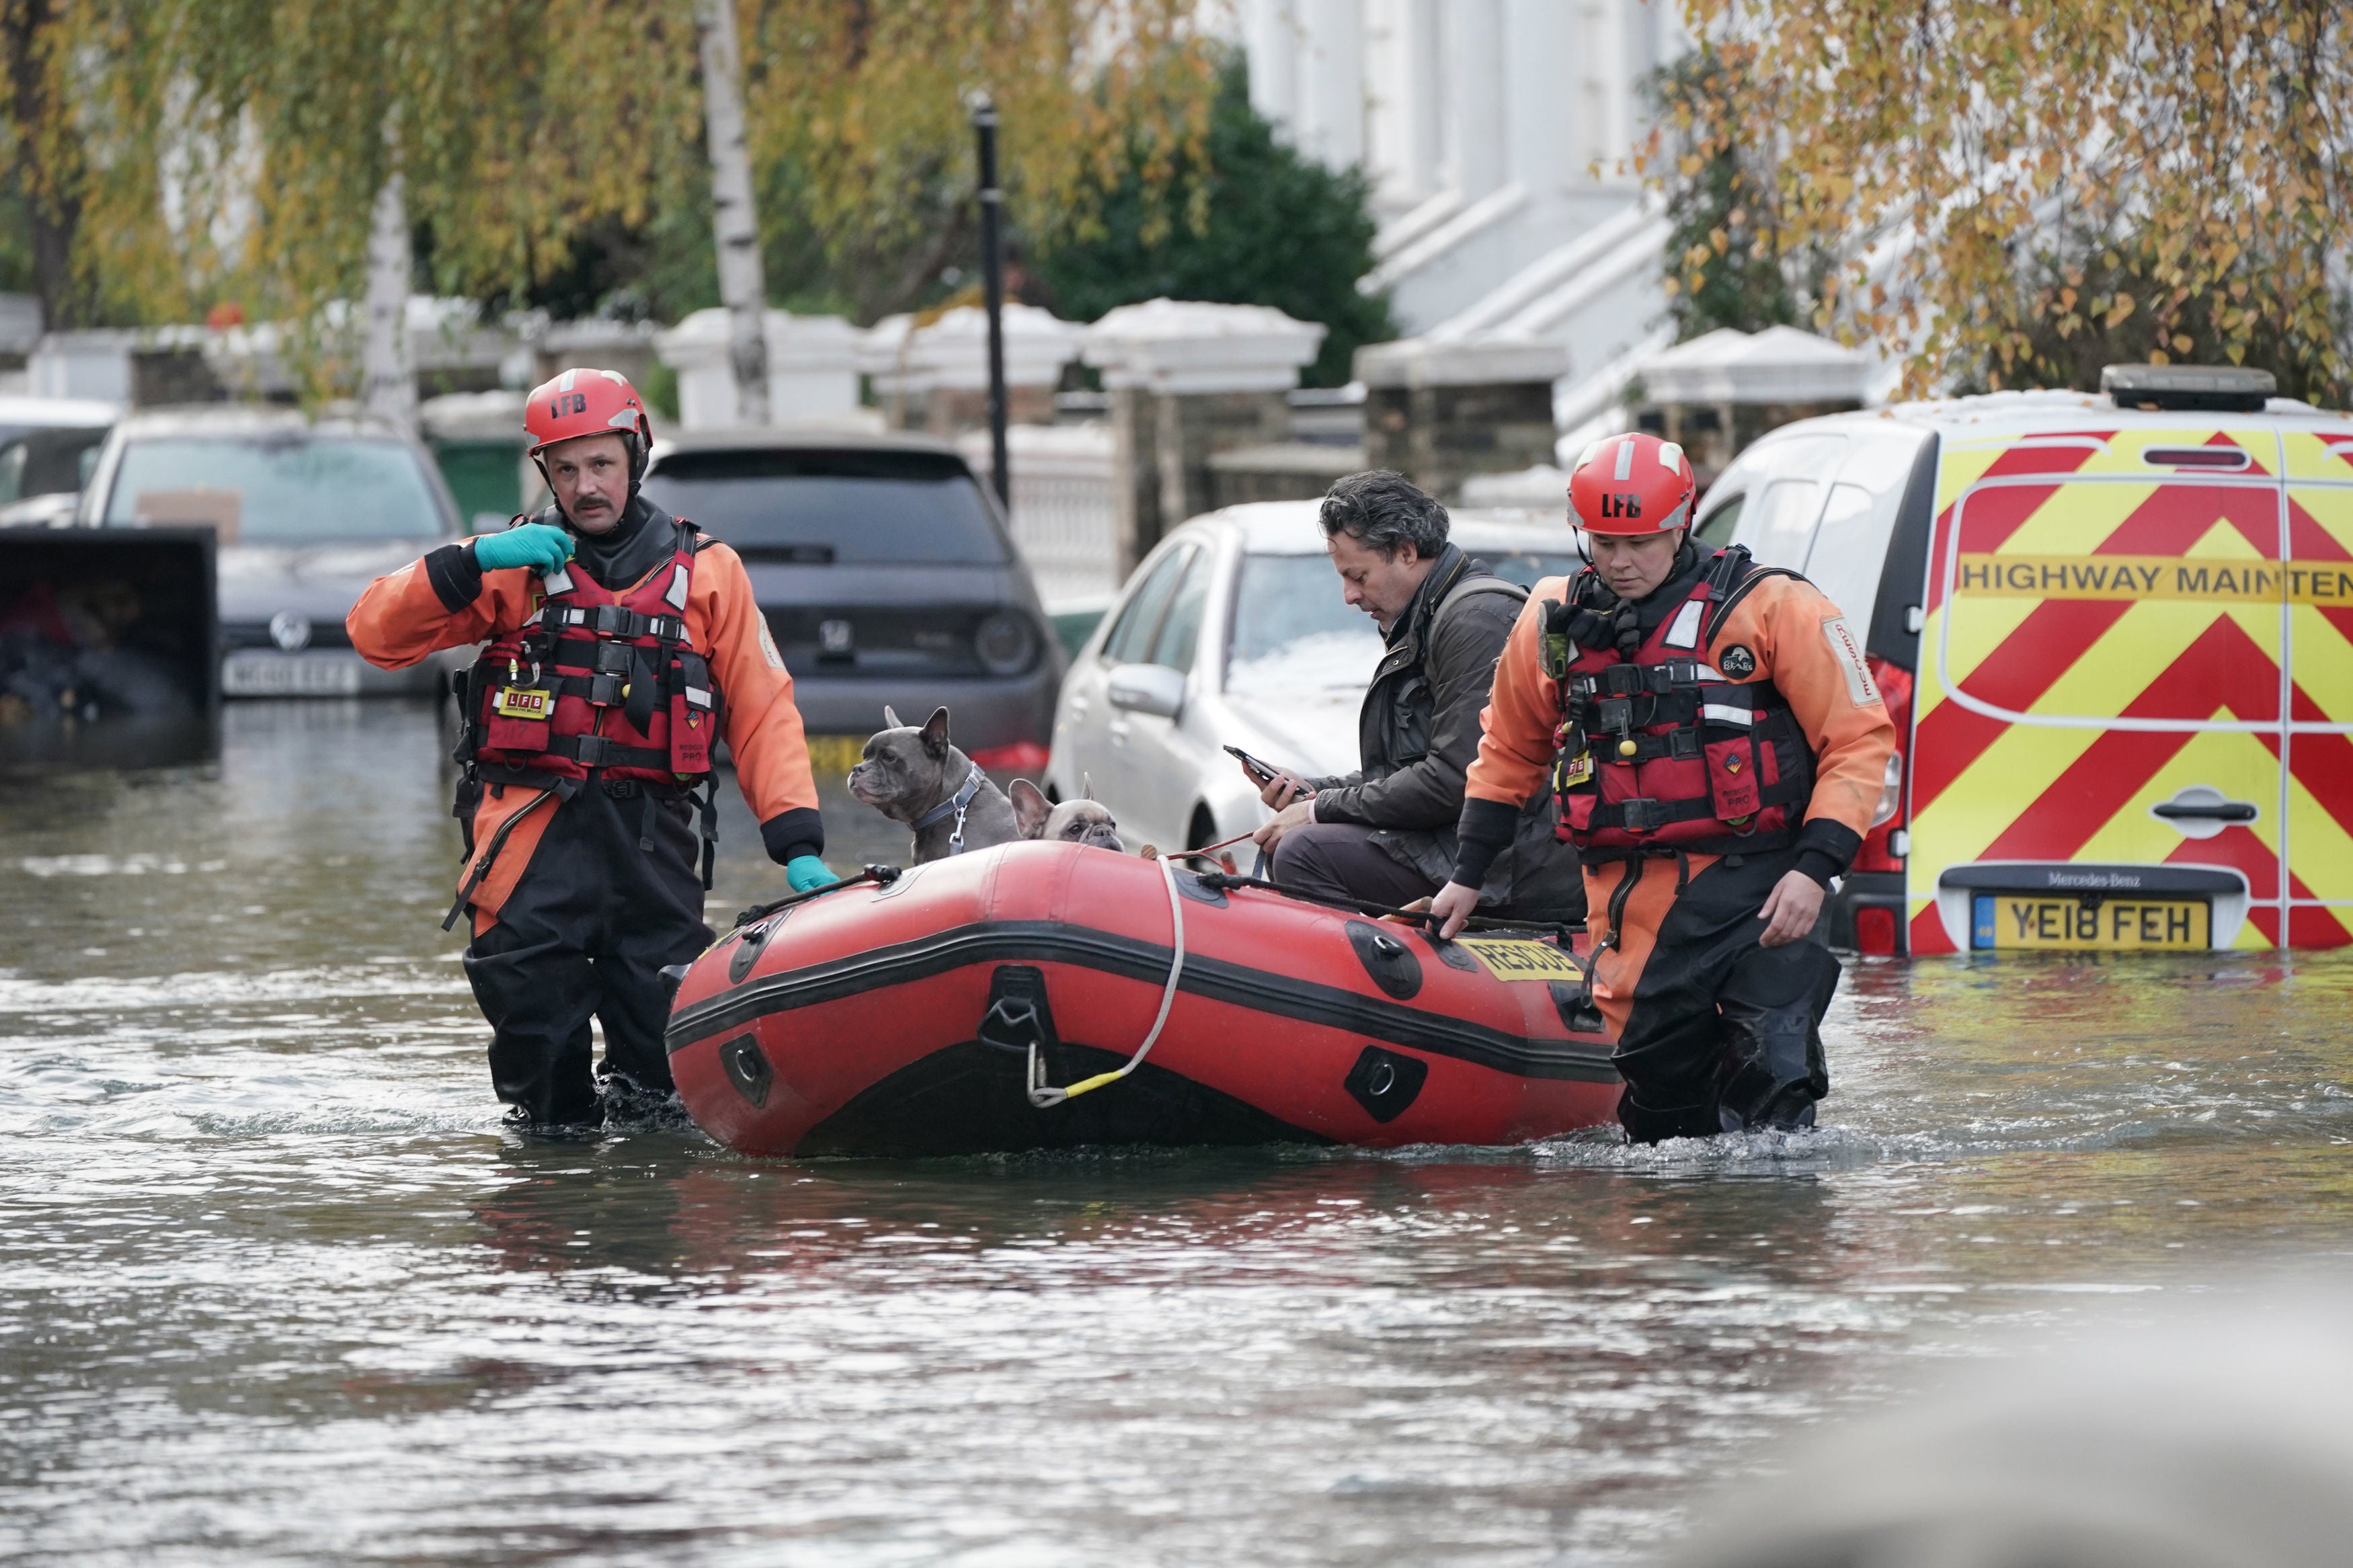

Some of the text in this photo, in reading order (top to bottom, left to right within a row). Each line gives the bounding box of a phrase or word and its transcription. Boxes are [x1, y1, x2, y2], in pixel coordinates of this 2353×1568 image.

[551, 393, 586, 419] LFB
[1602, 493, 1641, 518] LFB
[1962, 563, 2162, 591] HIGHWAY
[1835, 624, 1872, 696] RESCUE
[509, 694, 541, 707] LFB
[683, 752, 701, 761] PRO
[1569, 760, 1583, 775] FB
[1728, 794, 1750, 807] PRO
[2049, 872, 2141, 888] Mercedes-Benz
[2011, 903, 2190, 942] YE18 FEH
[1469, 944, 1579, 972] RESCUE
